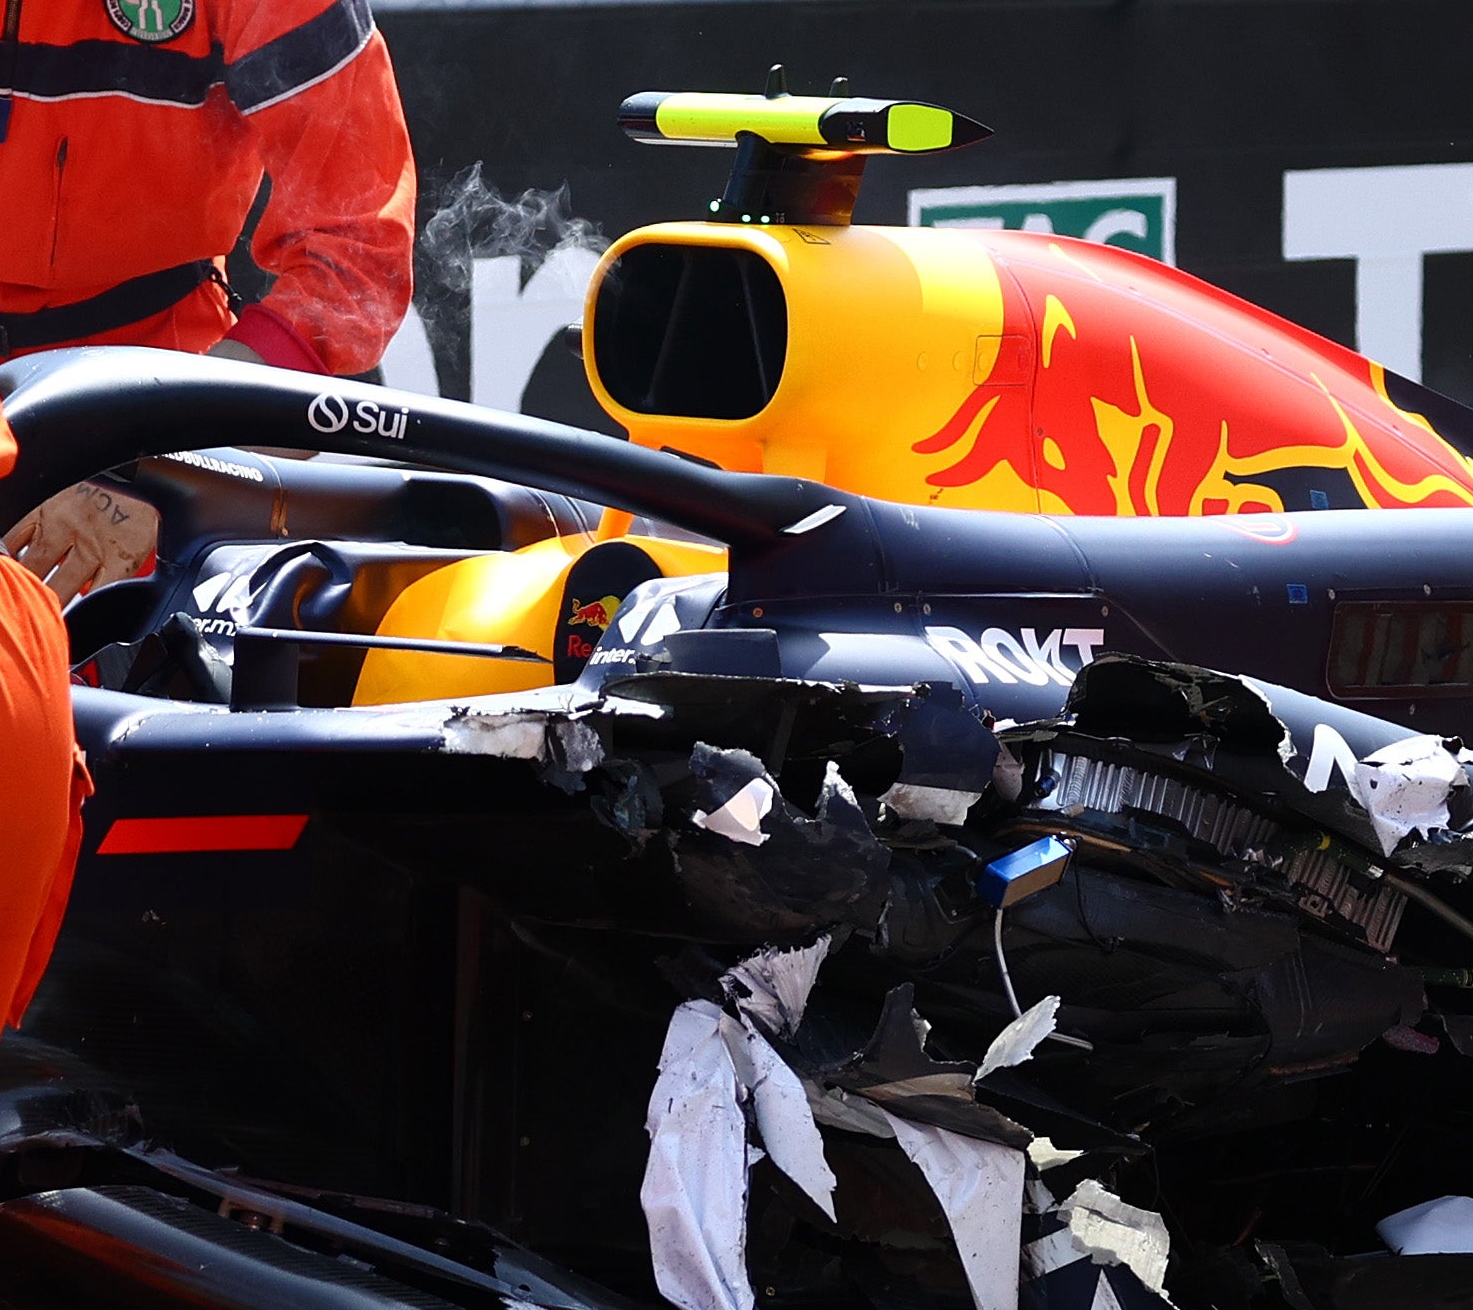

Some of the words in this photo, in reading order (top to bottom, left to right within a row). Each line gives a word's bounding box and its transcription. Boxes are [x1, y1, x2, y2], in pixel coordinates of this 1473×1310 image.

[353, 400, 410, 439] Sui
[567, 634, 593, 658] Re
[589, 646, 636, 665] inter.
